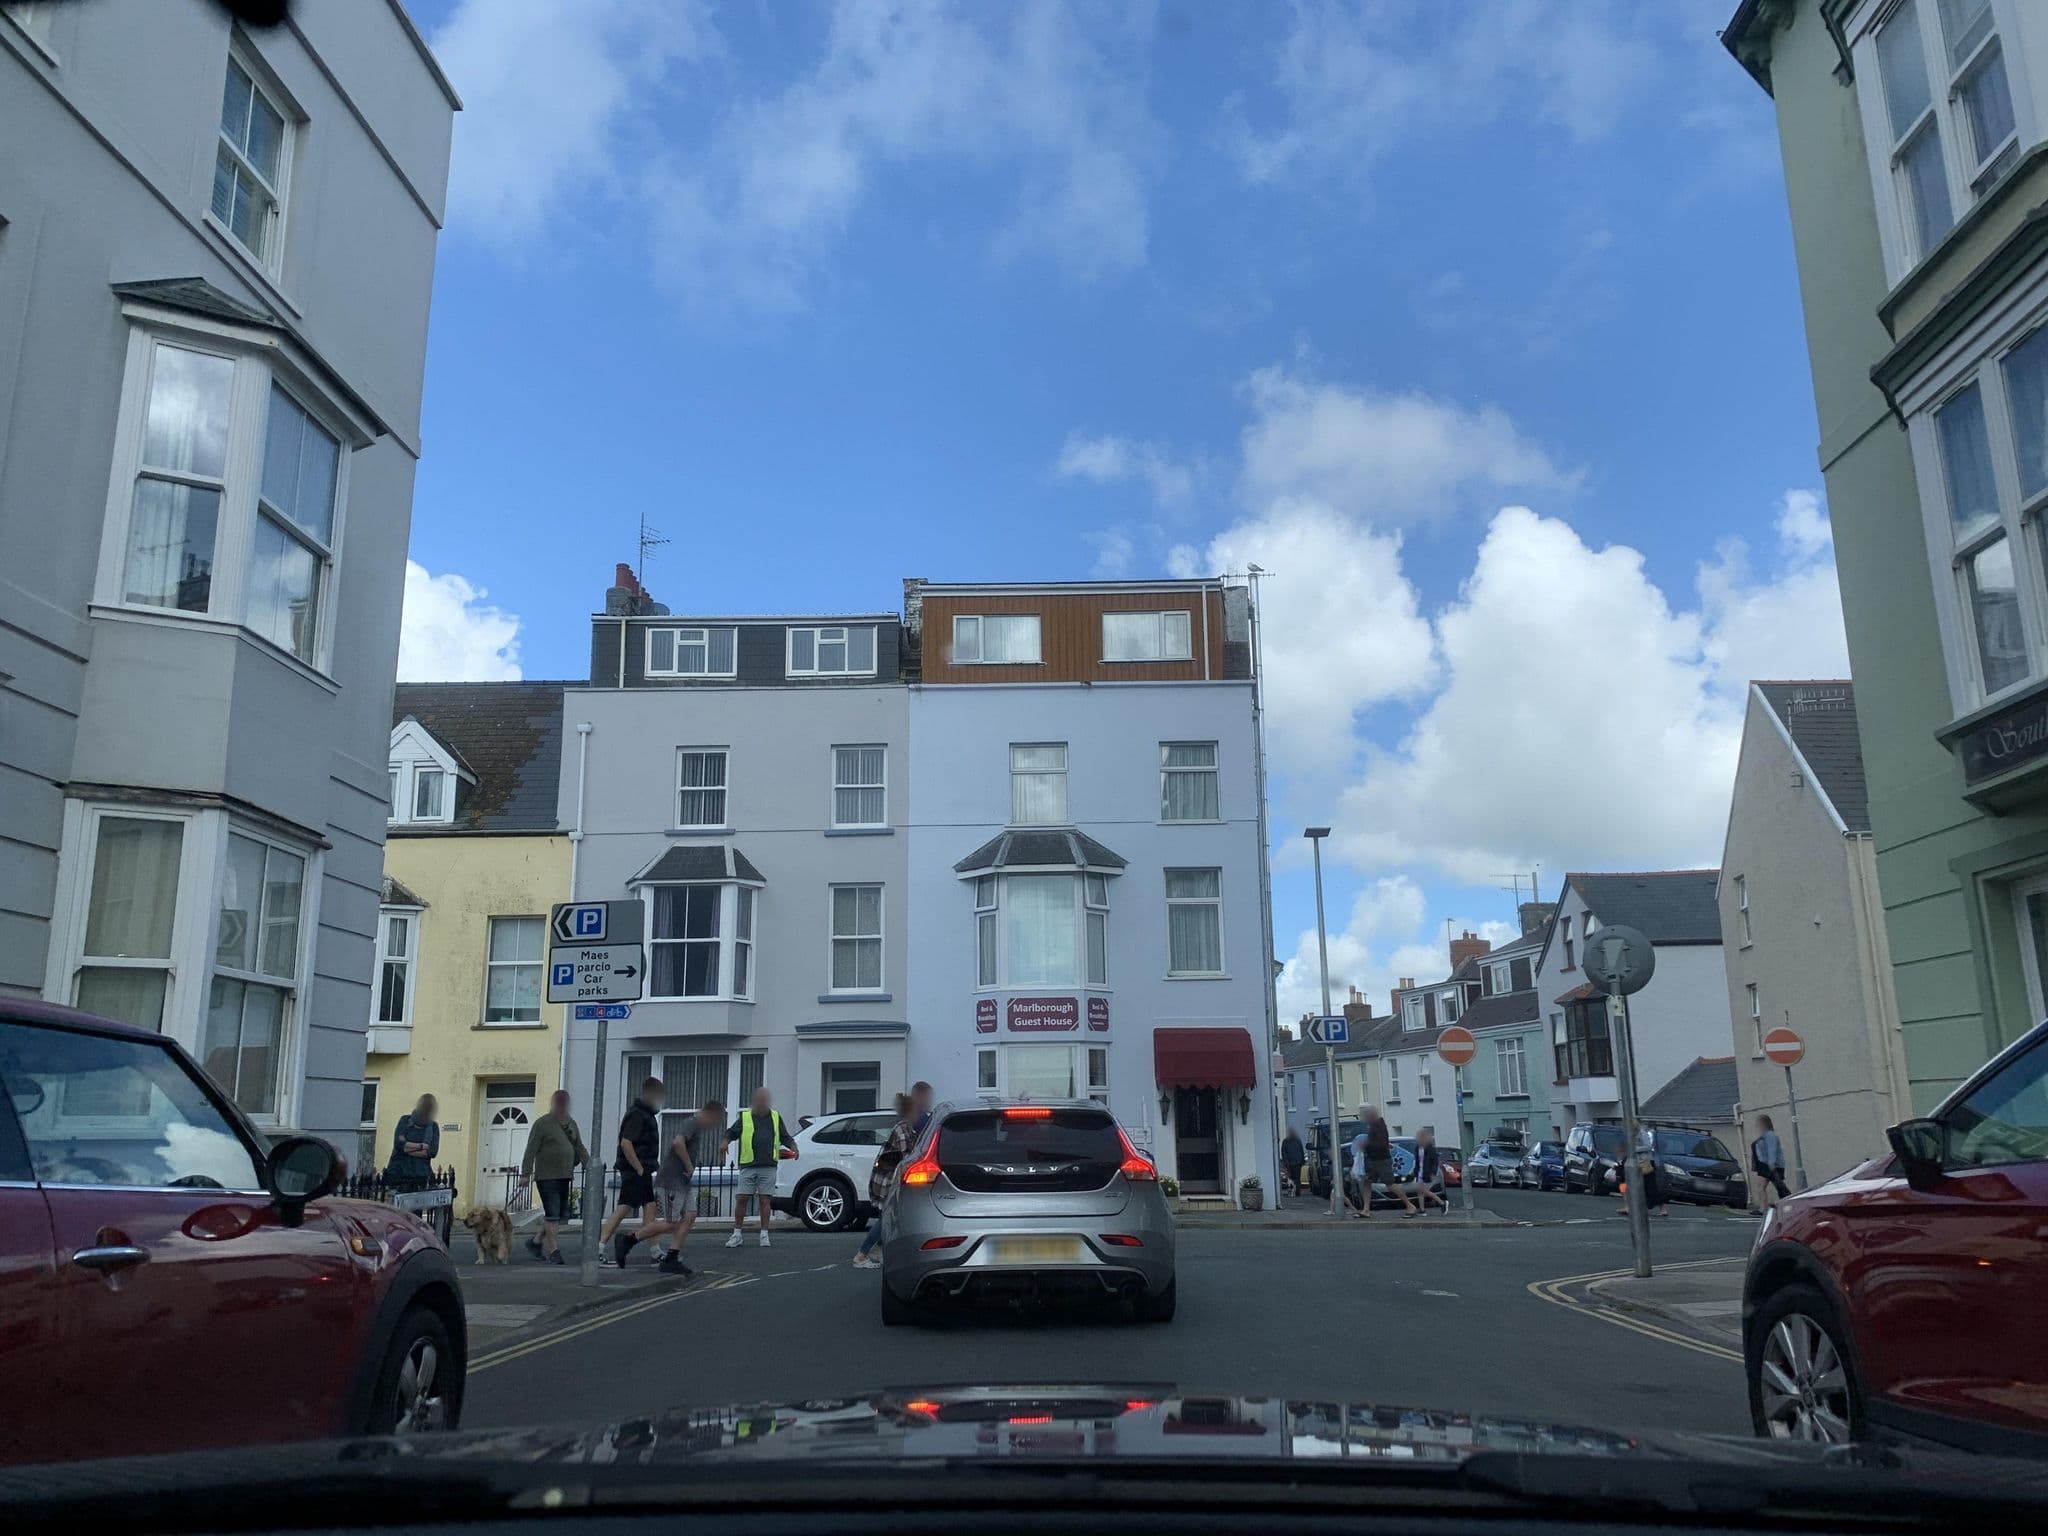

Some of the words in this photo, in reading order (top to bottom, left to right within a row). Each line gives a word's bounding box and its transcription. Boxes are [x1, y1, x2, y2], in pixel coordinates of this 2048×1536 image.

[582, 911, 599, 933] P
[581, 951, 609, 960] Maes
[577, 961, 611, 973] parcio
[558, 966, 571, 984] P
[584, 974, 604, 984] Car
[577, 986, 609, 997] parks
[1013, 1003, 1073, 1013] Marlborough
[1014, 1017, 1041, 1026] Guest
[1042, 1017, 1073, 1026] House
[1329, 1021, 1342, 1040] P
